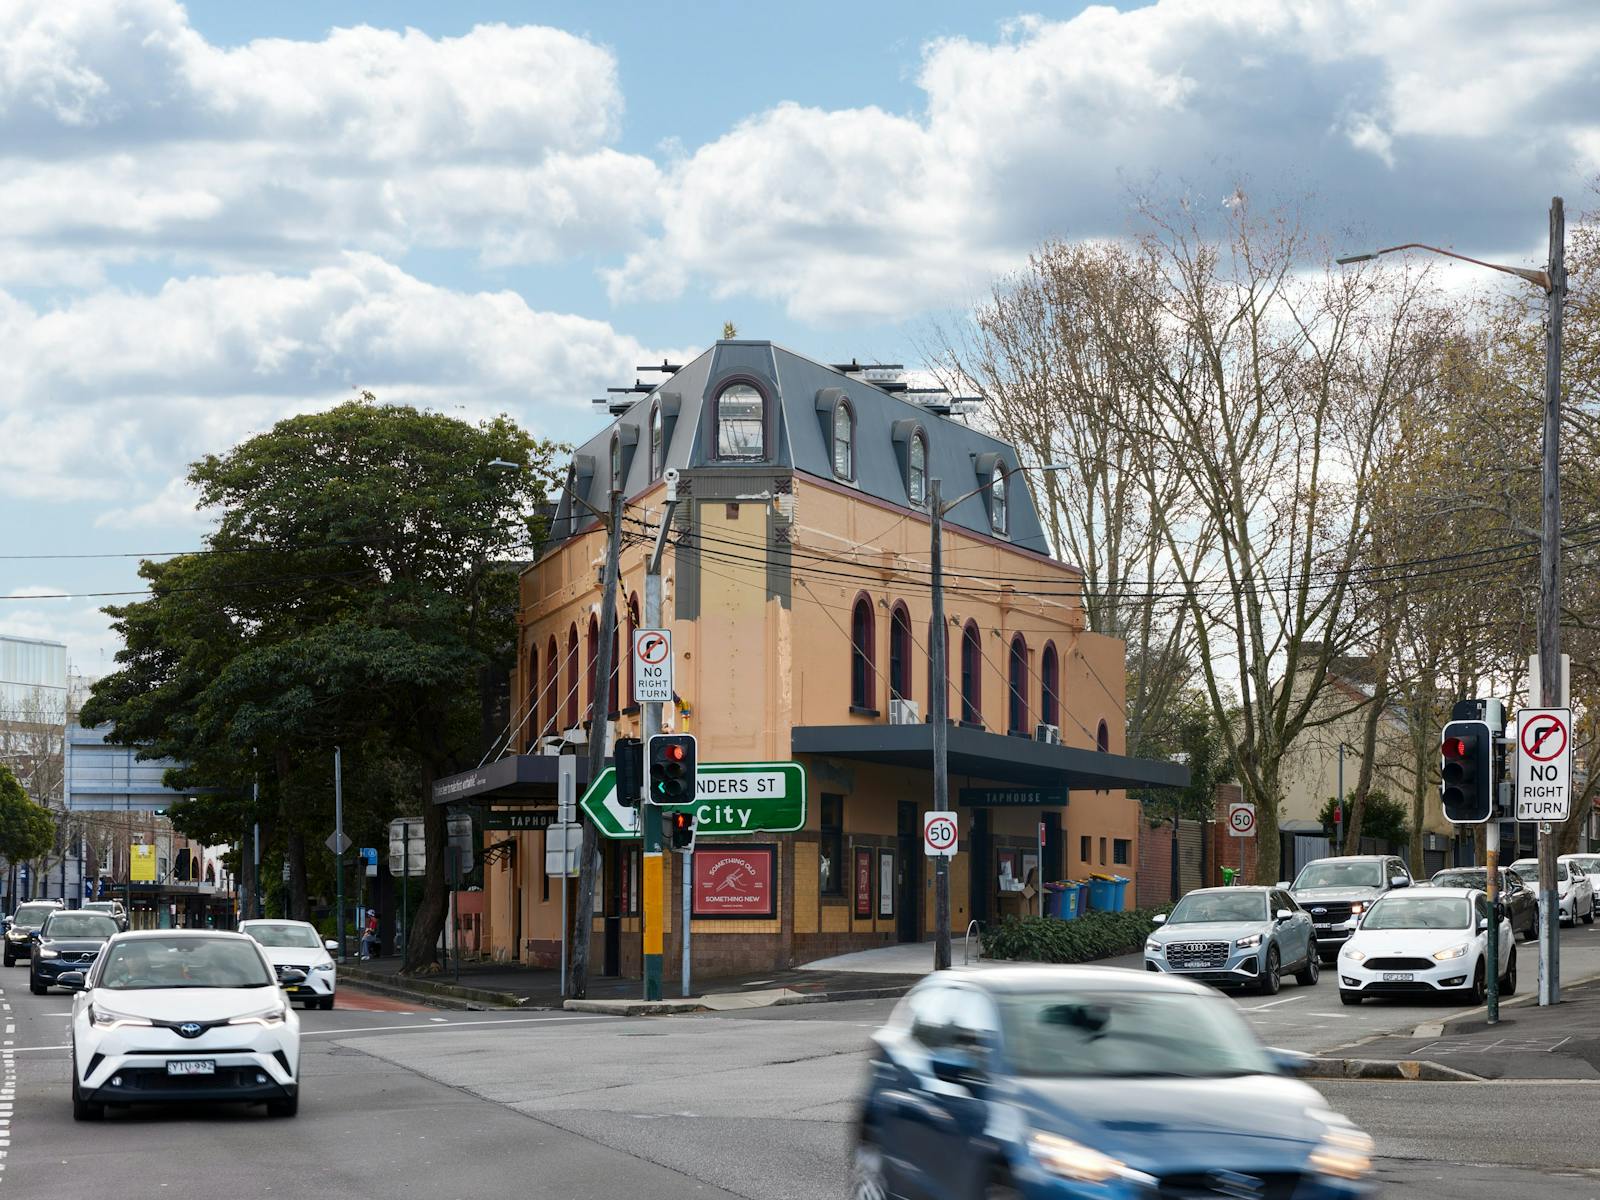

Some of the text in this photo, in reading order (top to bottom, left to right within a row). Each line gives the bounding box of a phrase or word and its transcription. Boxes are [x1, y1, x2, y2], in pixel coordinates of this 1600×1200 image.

[643, 667, 662, 677] NO
[1531, 765, 1558, 781] NO
[756, 778, 776, 792] ST
[985, 792, 1041, 803] TAPHOUSE
[1523, 786, 1563, 798] RIGHT
[1524, 802, 1562, 813] TURN
[697, 805, 752, 828] City
[1235, 815, 1250, 825] 50
[930, 827, 951, 841] 50
[709, 858, 756, 876] SOMETHING OLD
